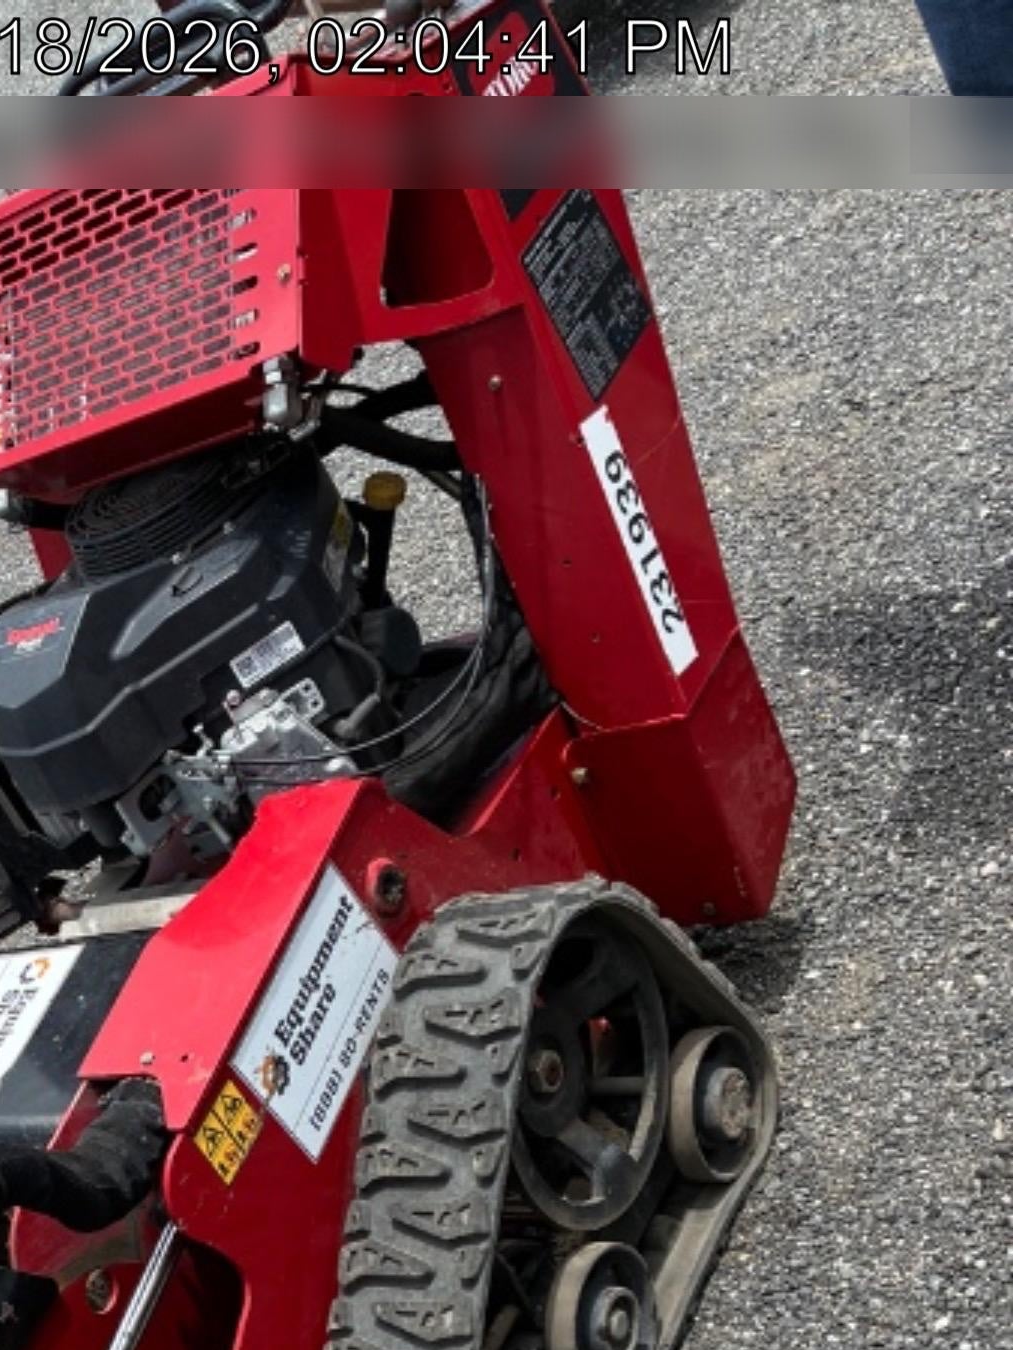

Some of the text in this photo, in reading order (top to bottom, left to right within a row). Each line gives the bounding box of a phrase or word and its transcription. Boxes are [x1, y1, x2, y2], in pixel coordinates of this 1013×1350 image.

[604, 450, 685, 635] 231939
[274, 895, 353, 1048] Equipment
[290, 982, 336, 1066] Share
